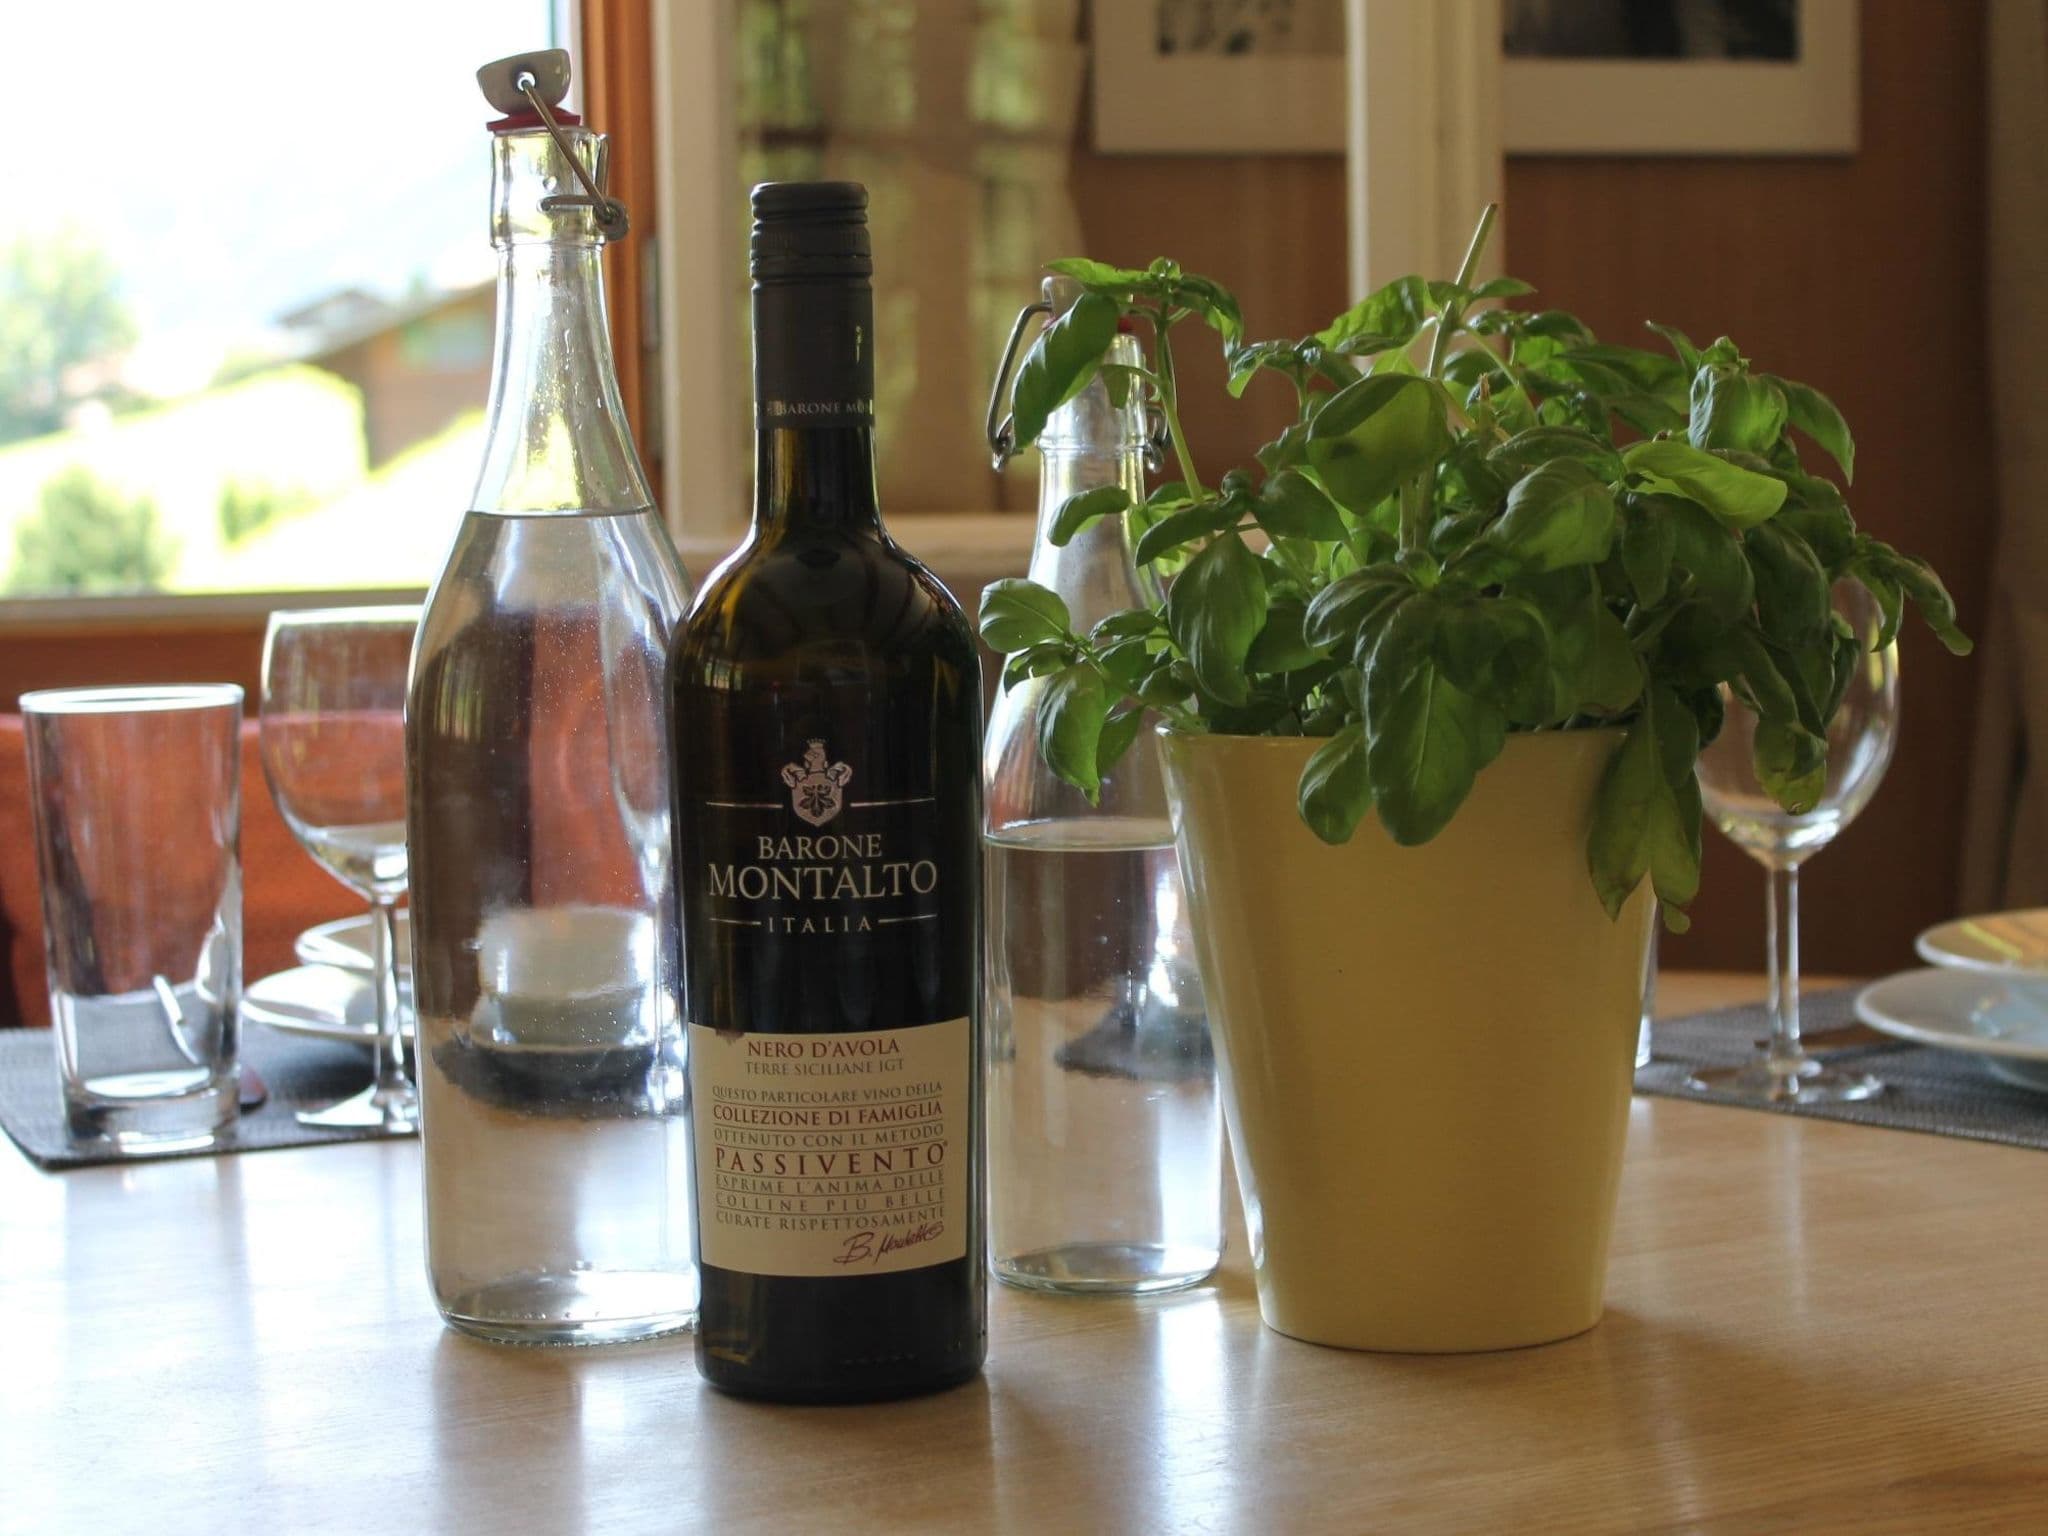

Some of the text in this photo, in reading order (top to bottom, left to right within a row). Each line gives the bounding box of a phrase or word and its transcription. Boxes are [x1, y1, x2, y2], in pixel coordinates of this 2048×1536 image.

[776, 402, 840, 416] BARONE
[758, 834, 882, 860] BARONE
[709, 860, 937, 900] MONTALTO
[769, 916, 872, 933] ITALIA
[748, 1038, 900, 1058] NERO D'AVOLA
[745, 1058, 904, 1076] TERRE SICILIANE IGT
[712, 1081, 943, 1103] QUESTO PARTICOLARE VINO DELLA
[713, 1101, 943, 1126] COLLEZIONE DI FAMIGLIA
[714, 1123, 944, 1147] OTTENUTO CON IL METODO
[716, 1143, 944, 1175] PASSIVENTO
[716, 1169, 944, 1194] ESPRIME L'ANIMA DELLE
[715, 1192, 808, 1212] COLLINE
[886, 1187, 944, 1208] BELLE
[716, 1206, 944, 1231] CURATE RISPETTOSAMENTE
